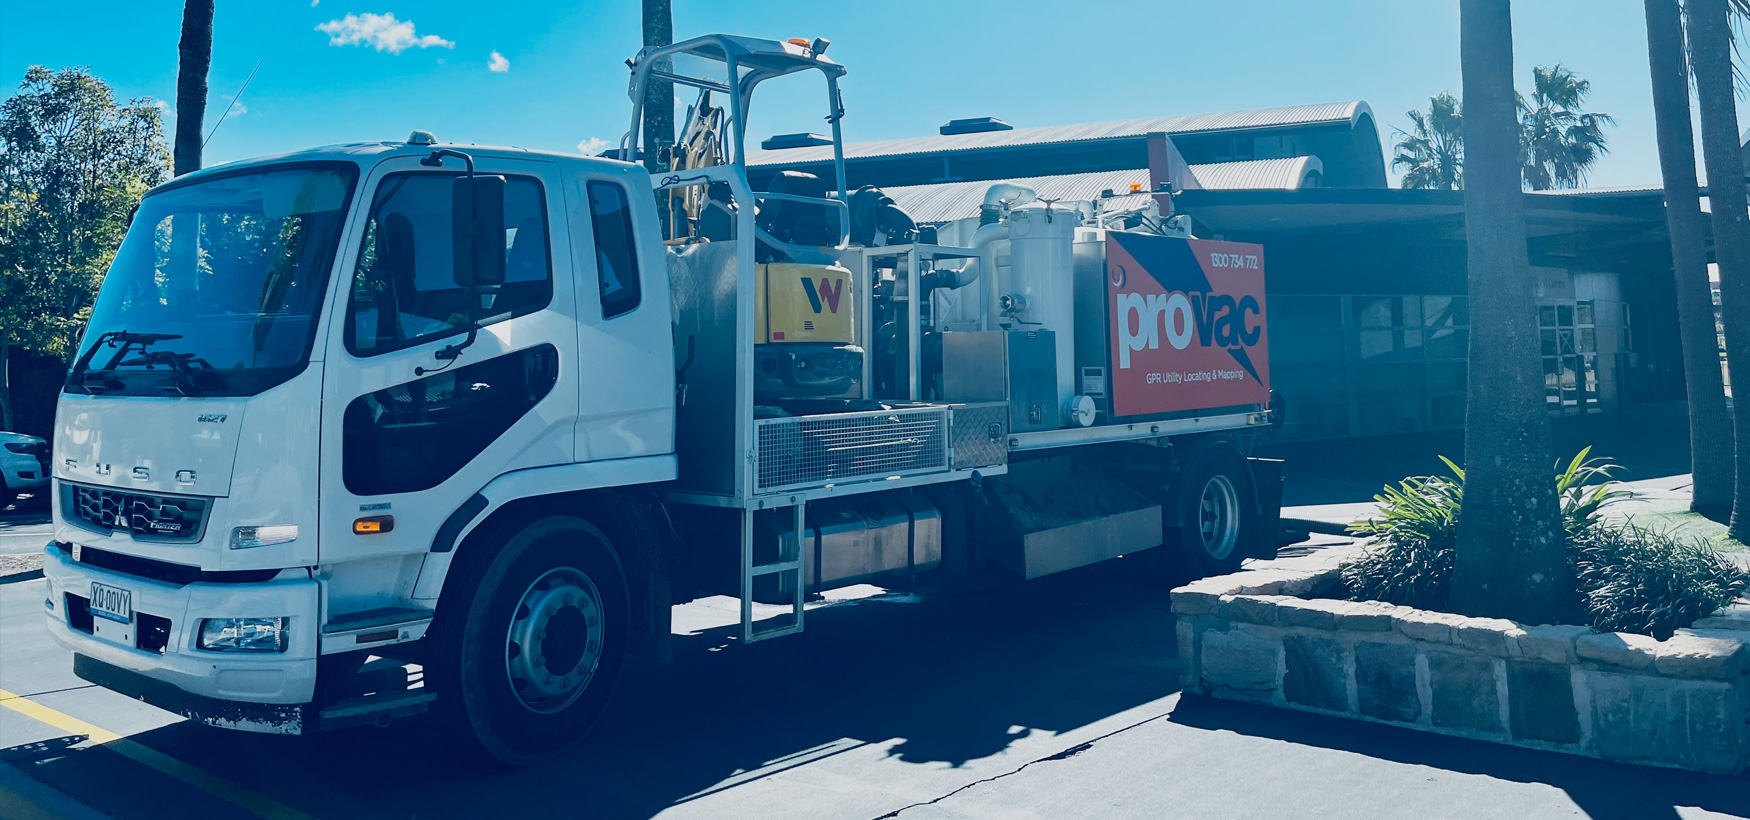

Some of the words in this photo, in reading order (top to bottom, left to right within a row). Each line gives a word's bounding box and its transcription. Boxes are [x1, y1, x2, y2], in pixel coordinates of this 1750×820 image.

[1211, 253, 1228, 268] 1300
[1230, 254, 1244, 268] 734
[1245, 255, 1258, 269] 772
[1117, 292, 1261, 369] provac
[1146, 373, 1161, 384] GPR
[1163, 371, 1182, 384] Utility
[1184, 370, 1211, 383] Locating
[1212, 370, 1217, 380] &
[1218, 369, 1243, 381] Mapping
[65, 459, 198, 486] FUSO
